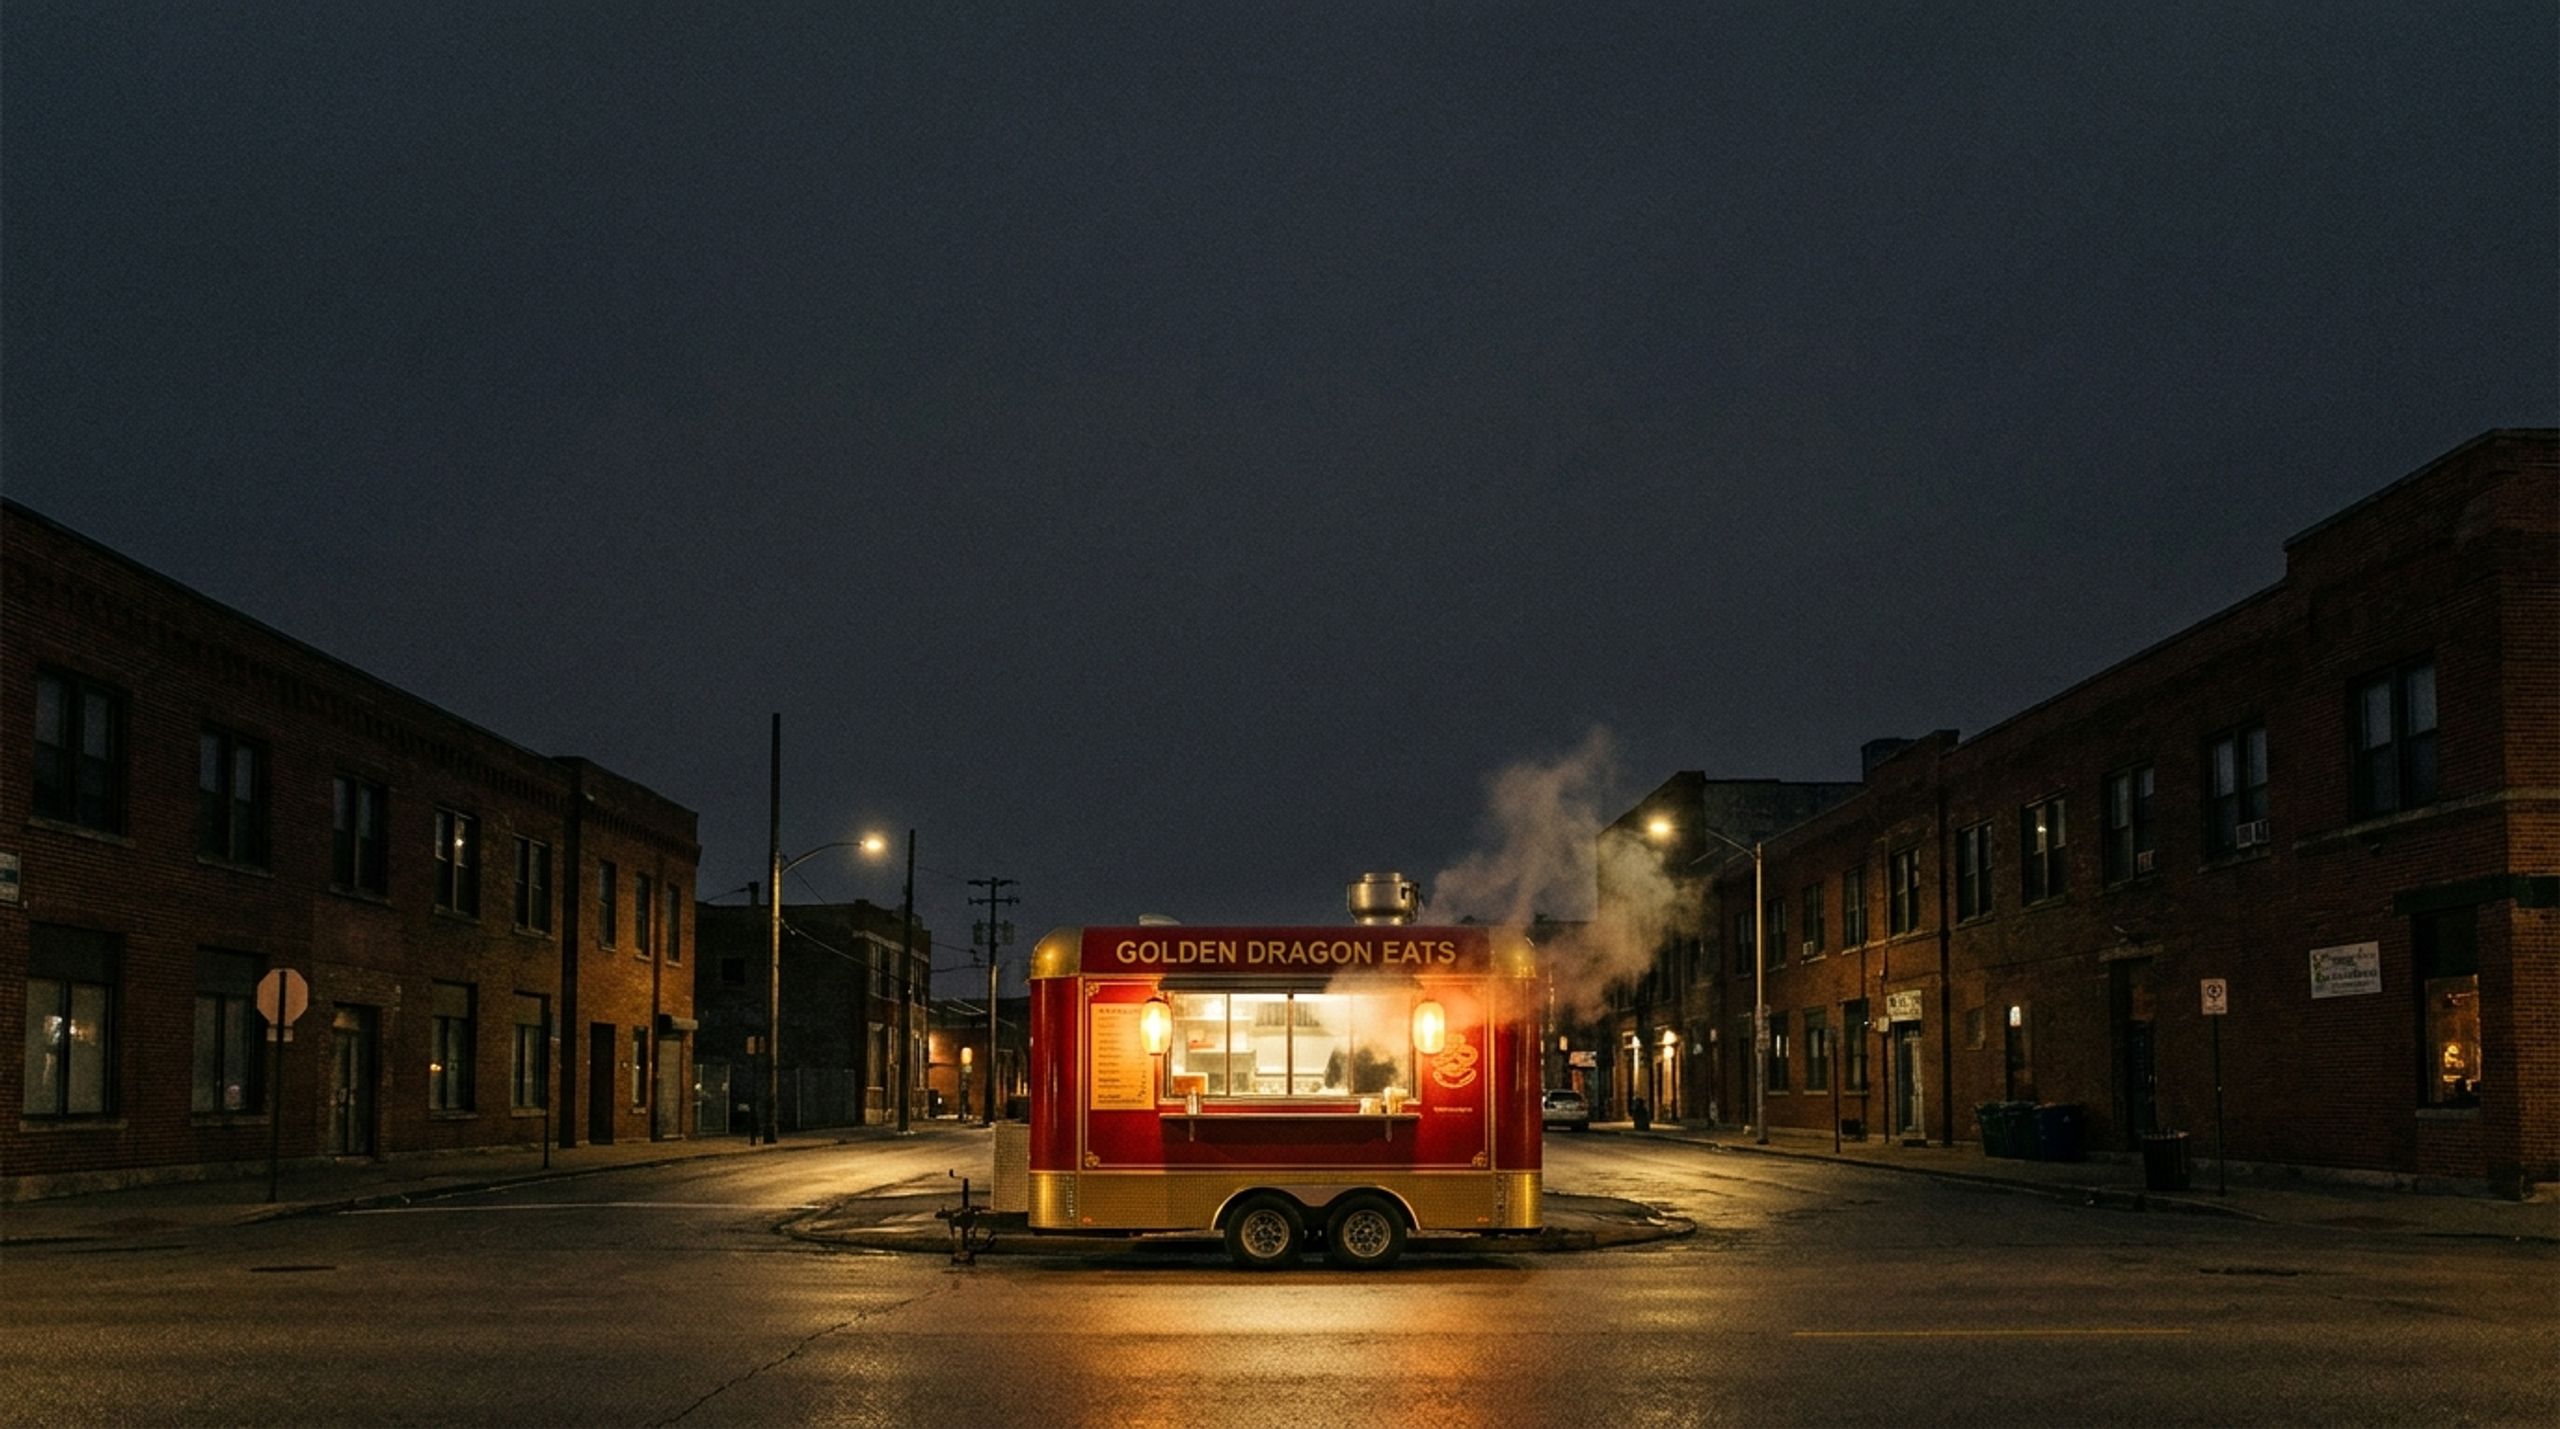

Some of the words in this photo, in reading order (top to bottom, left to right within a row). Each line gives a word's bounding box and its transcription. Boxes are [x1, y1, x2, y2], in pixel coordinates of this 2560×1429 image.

[1116, 941, 1237, 964] GOLDEN
[1248, 941, 1372, 964] DRAGON
[1384, 941, 1456, 964] EATS
